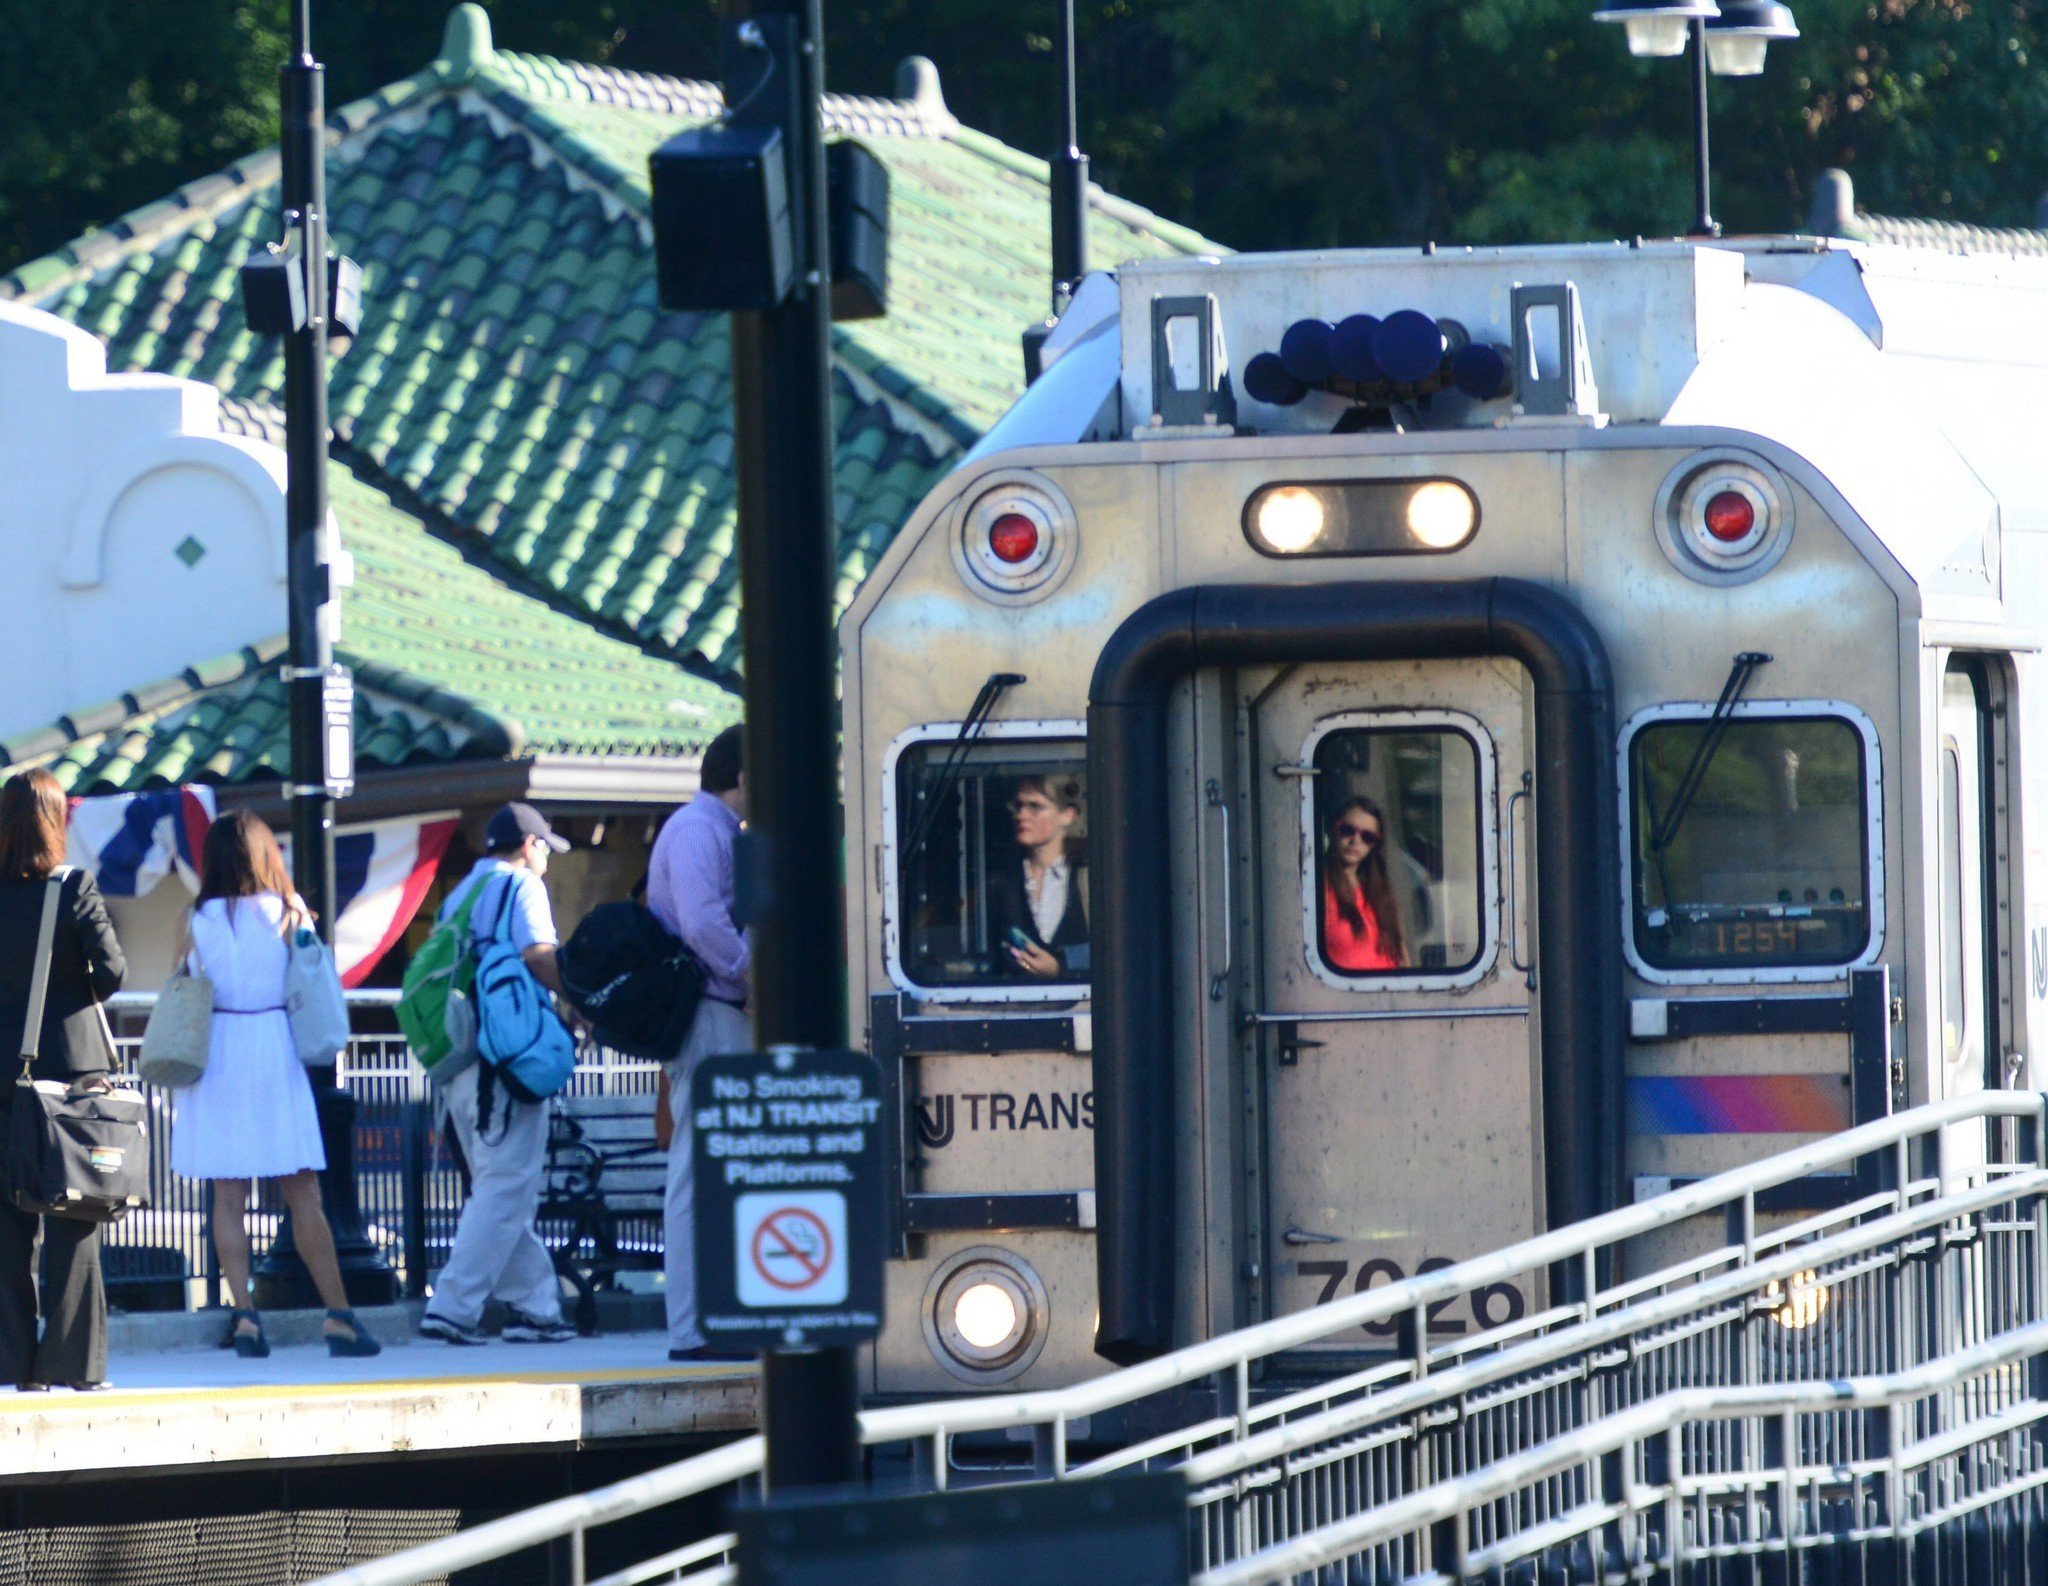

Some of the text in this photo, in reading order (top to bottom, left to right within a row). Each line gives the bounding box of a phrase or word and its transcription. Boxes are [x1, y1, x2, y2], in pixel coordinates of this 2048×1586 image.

[713, 1074, 861, 1100] No Smoking
[697, 1100, 880, 1129] at NJ TRANSIT
[708, 1130, 863, 1157] Stations and
